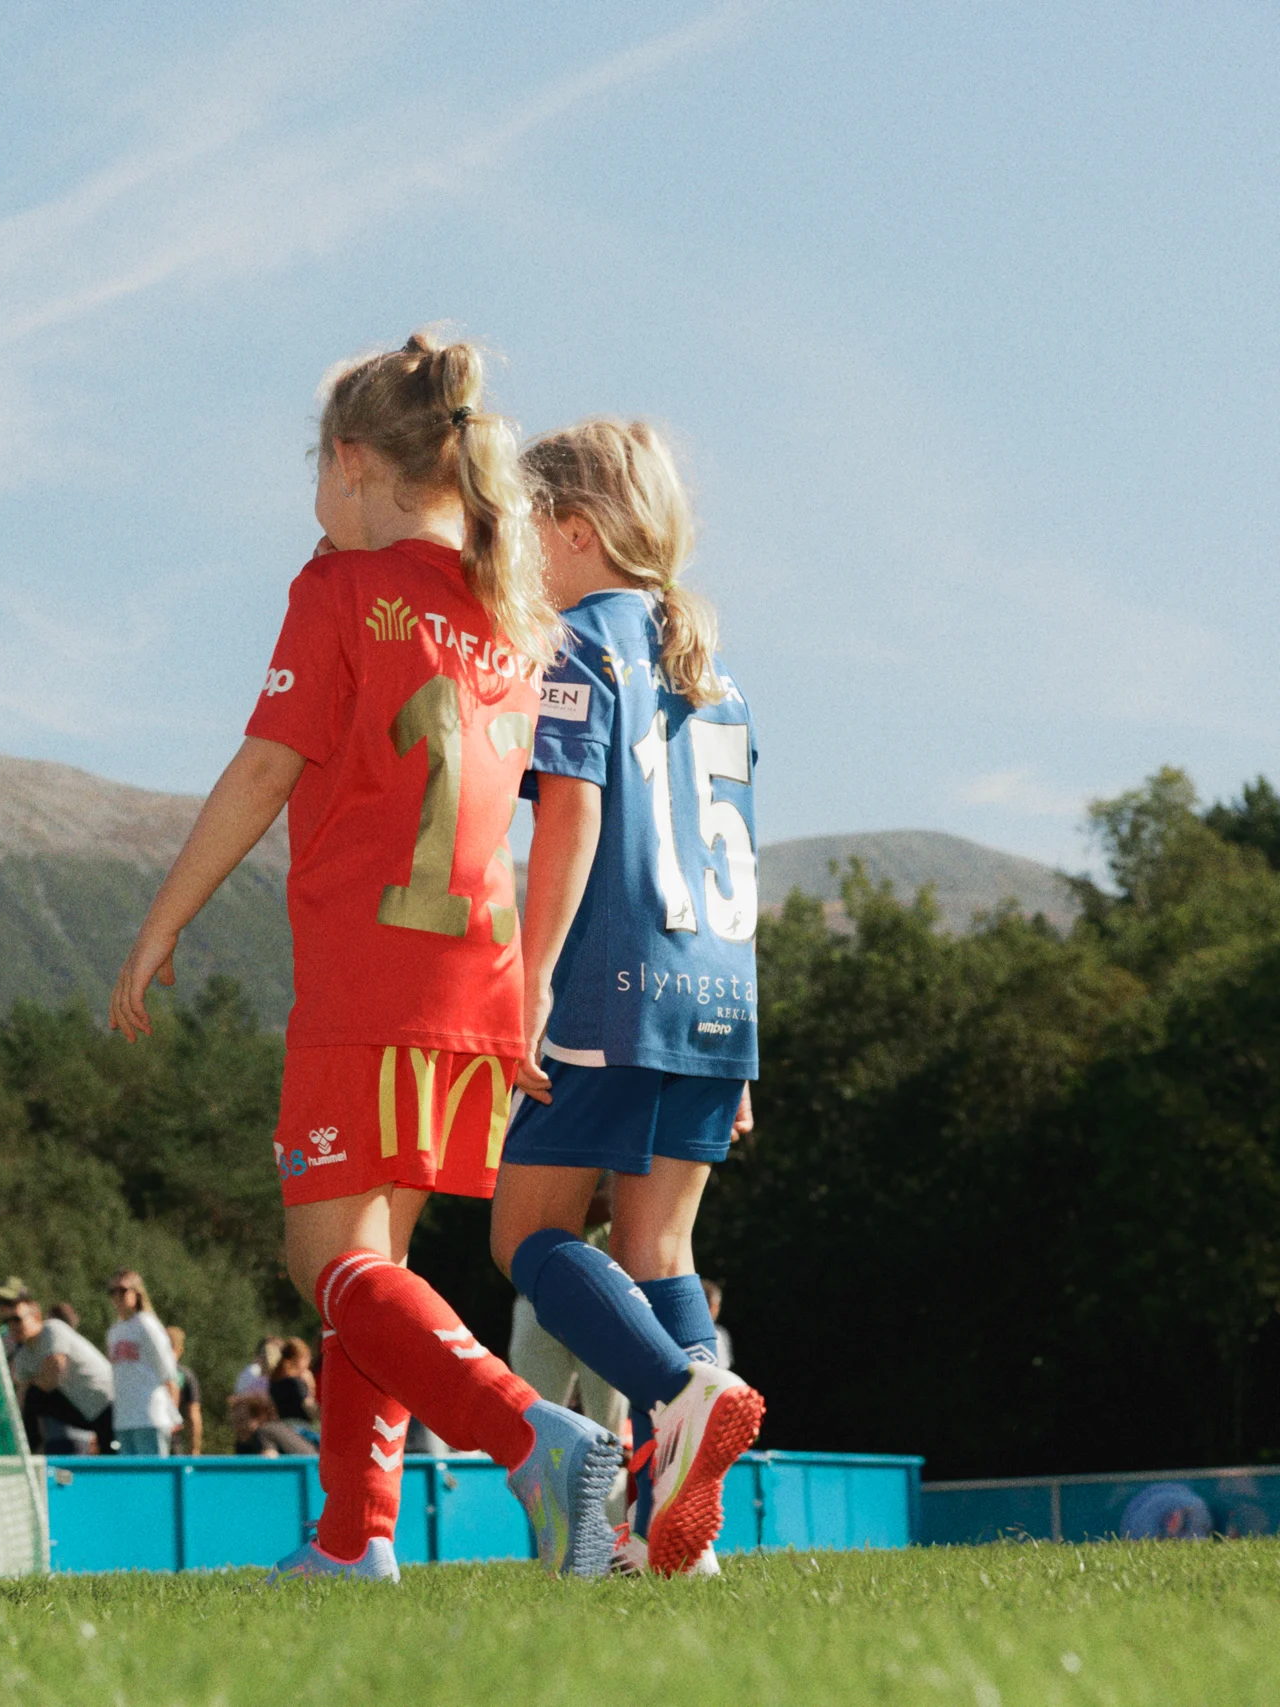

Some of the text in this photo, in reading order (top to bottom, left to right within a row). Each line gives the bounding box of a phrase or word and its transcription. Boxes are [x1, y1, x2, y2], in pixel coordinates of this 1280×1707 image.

[631, 708, 758, 943] 15
[697, 1020, 732, 1035] umbro
[307, 1149, 348, 1168] hummel
